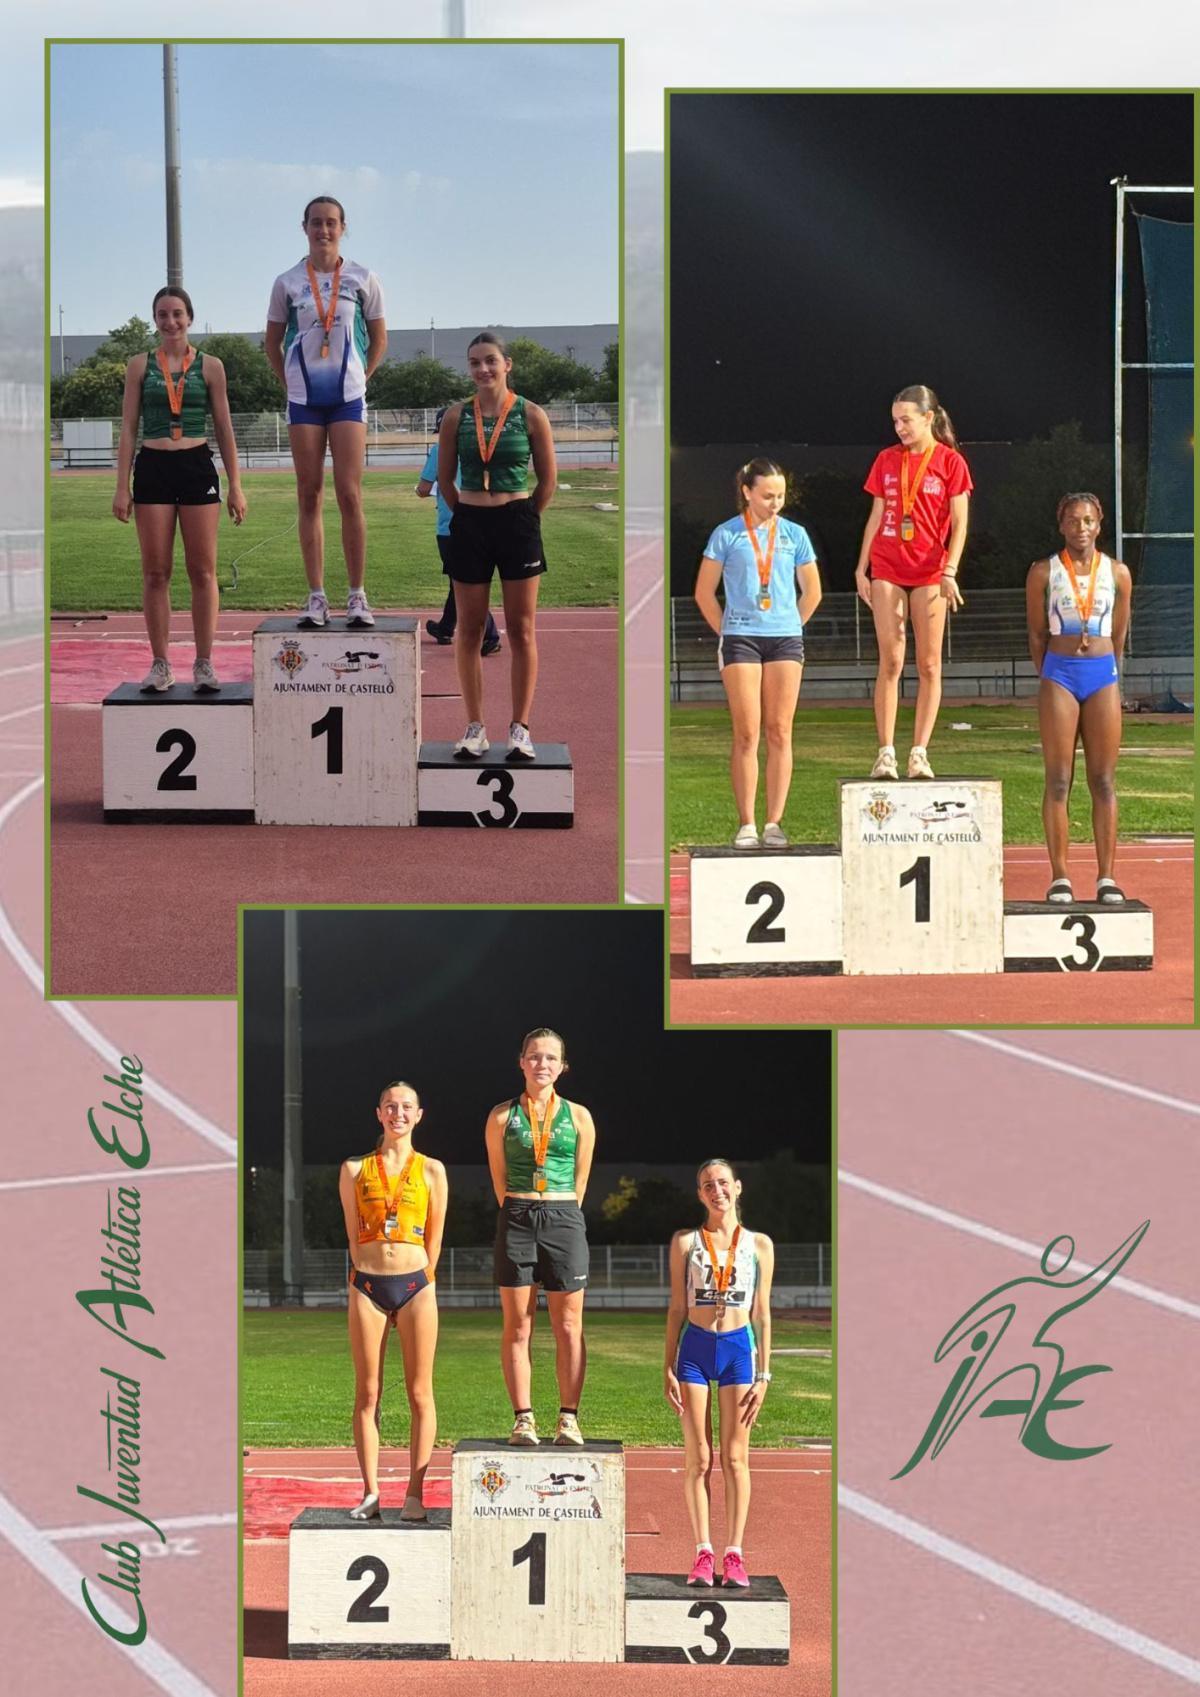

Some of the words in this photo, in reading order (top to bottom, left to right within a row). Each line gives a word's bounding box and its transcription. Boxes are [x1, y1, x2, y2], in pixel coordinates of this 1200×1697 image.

[273, 682, 332, 694] AJUNTAMENT
[335, 683, 347, 694] DE
[155, 728, 197, 791] 2
[311, 706, 344, 775] 1
[477, 769, 519, 827] 3
[862, 832, 919, 844] AJUNTAMENT
[923, 832, 934, 842] DE
[745, 881, 785, 943] 2
[900, 856, 930, 922] 1
[1060, 914, 1101, 972] 3
[473, 1506, 535, 1519] AJUNTAMENT
[538, 1507, 551, 1518] DE
[347, 1555, 389, 1623] 2
[513, 1533, 546, 1605] 1
[688, 1601, 731, 1665] 3
